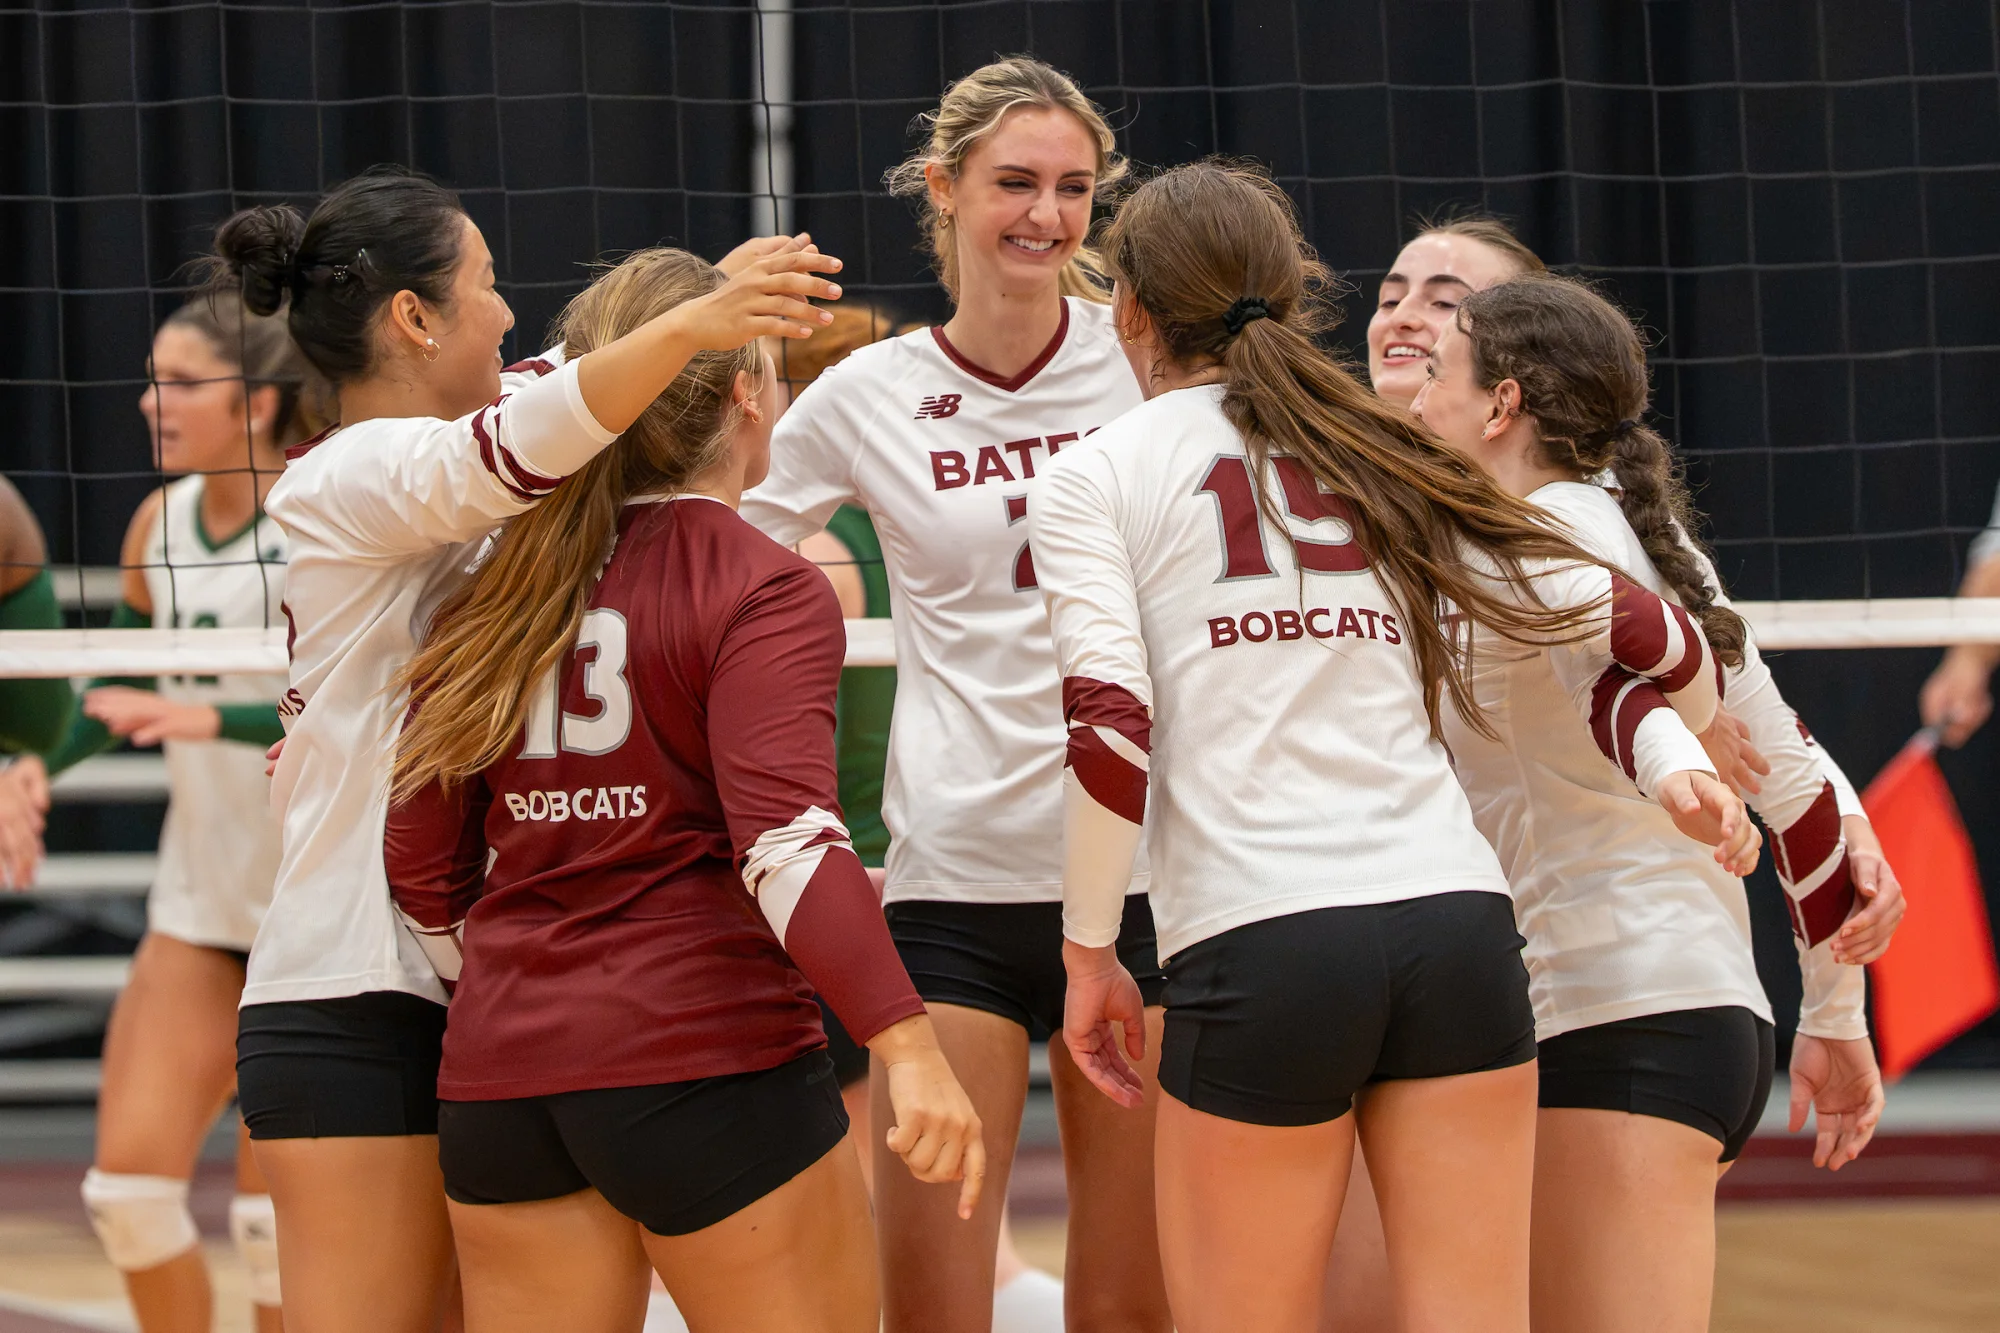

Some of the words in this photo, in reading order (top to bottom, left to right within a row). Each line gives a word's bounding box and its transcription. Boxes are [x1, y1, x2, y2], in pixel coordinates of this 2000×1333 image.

[929, 426, 1102, 491] BAT
[1192, 453, 1383, 584] 15
[1208, 607, 1401, 649] BOBCATS
[516, 607, 632, 760] 13
[504, 785, 647, 822] BOBCATS
